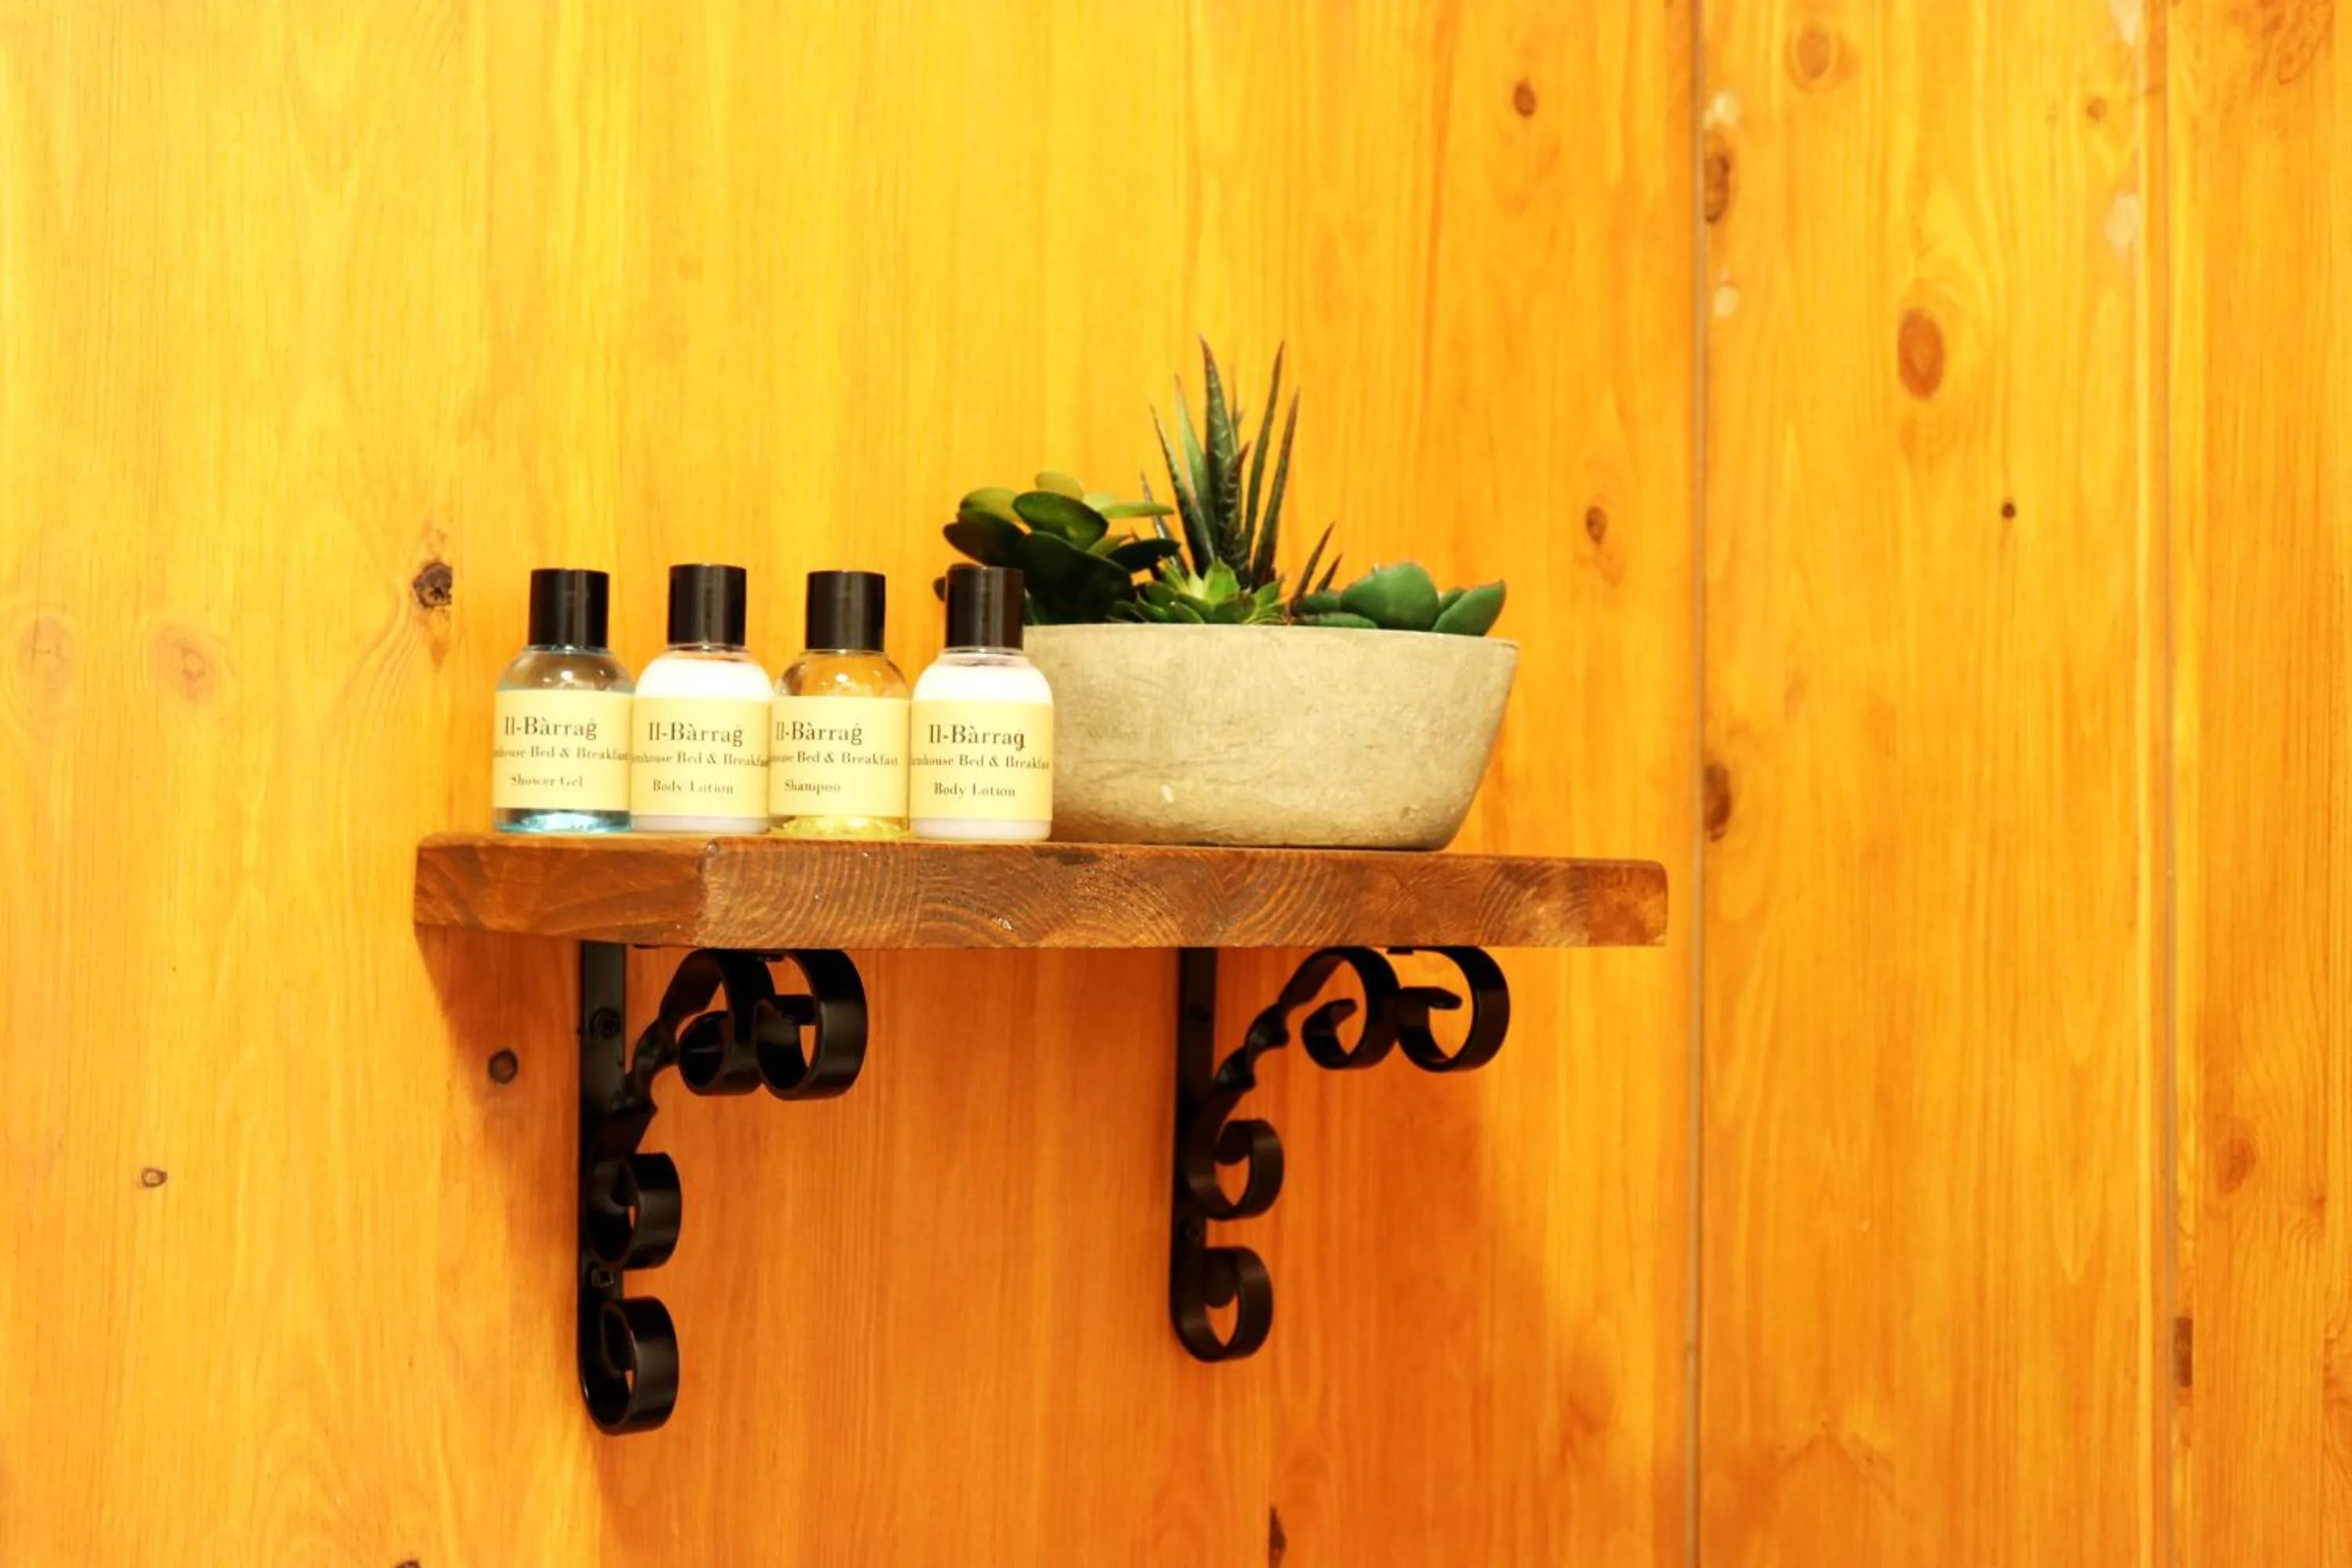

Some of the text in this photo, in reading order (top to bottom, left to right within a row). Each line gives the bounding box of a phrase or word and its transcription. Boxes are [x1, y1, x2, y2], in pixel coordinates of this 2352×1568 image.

[530, 745, 554, 758] Bed
[559, 747, 570, 759] &
[677, 751, 702, 764] Bed
[706, 753, 717, 765] &
[797, 750, 820, 764] Bed
[824, 752, 835, 764] &
[841, 752, 898, 766] Breakfast
[959, 753, 984, 767] Bed
[989, 755, 1000, 768] &
[510, 773, 583, 787] Shower Gel
[652, 779, 734, 795] Body Lotion
[784, 779, 841, 797] Shampoo
[934, 782, 1016, 799] Body Lotion
